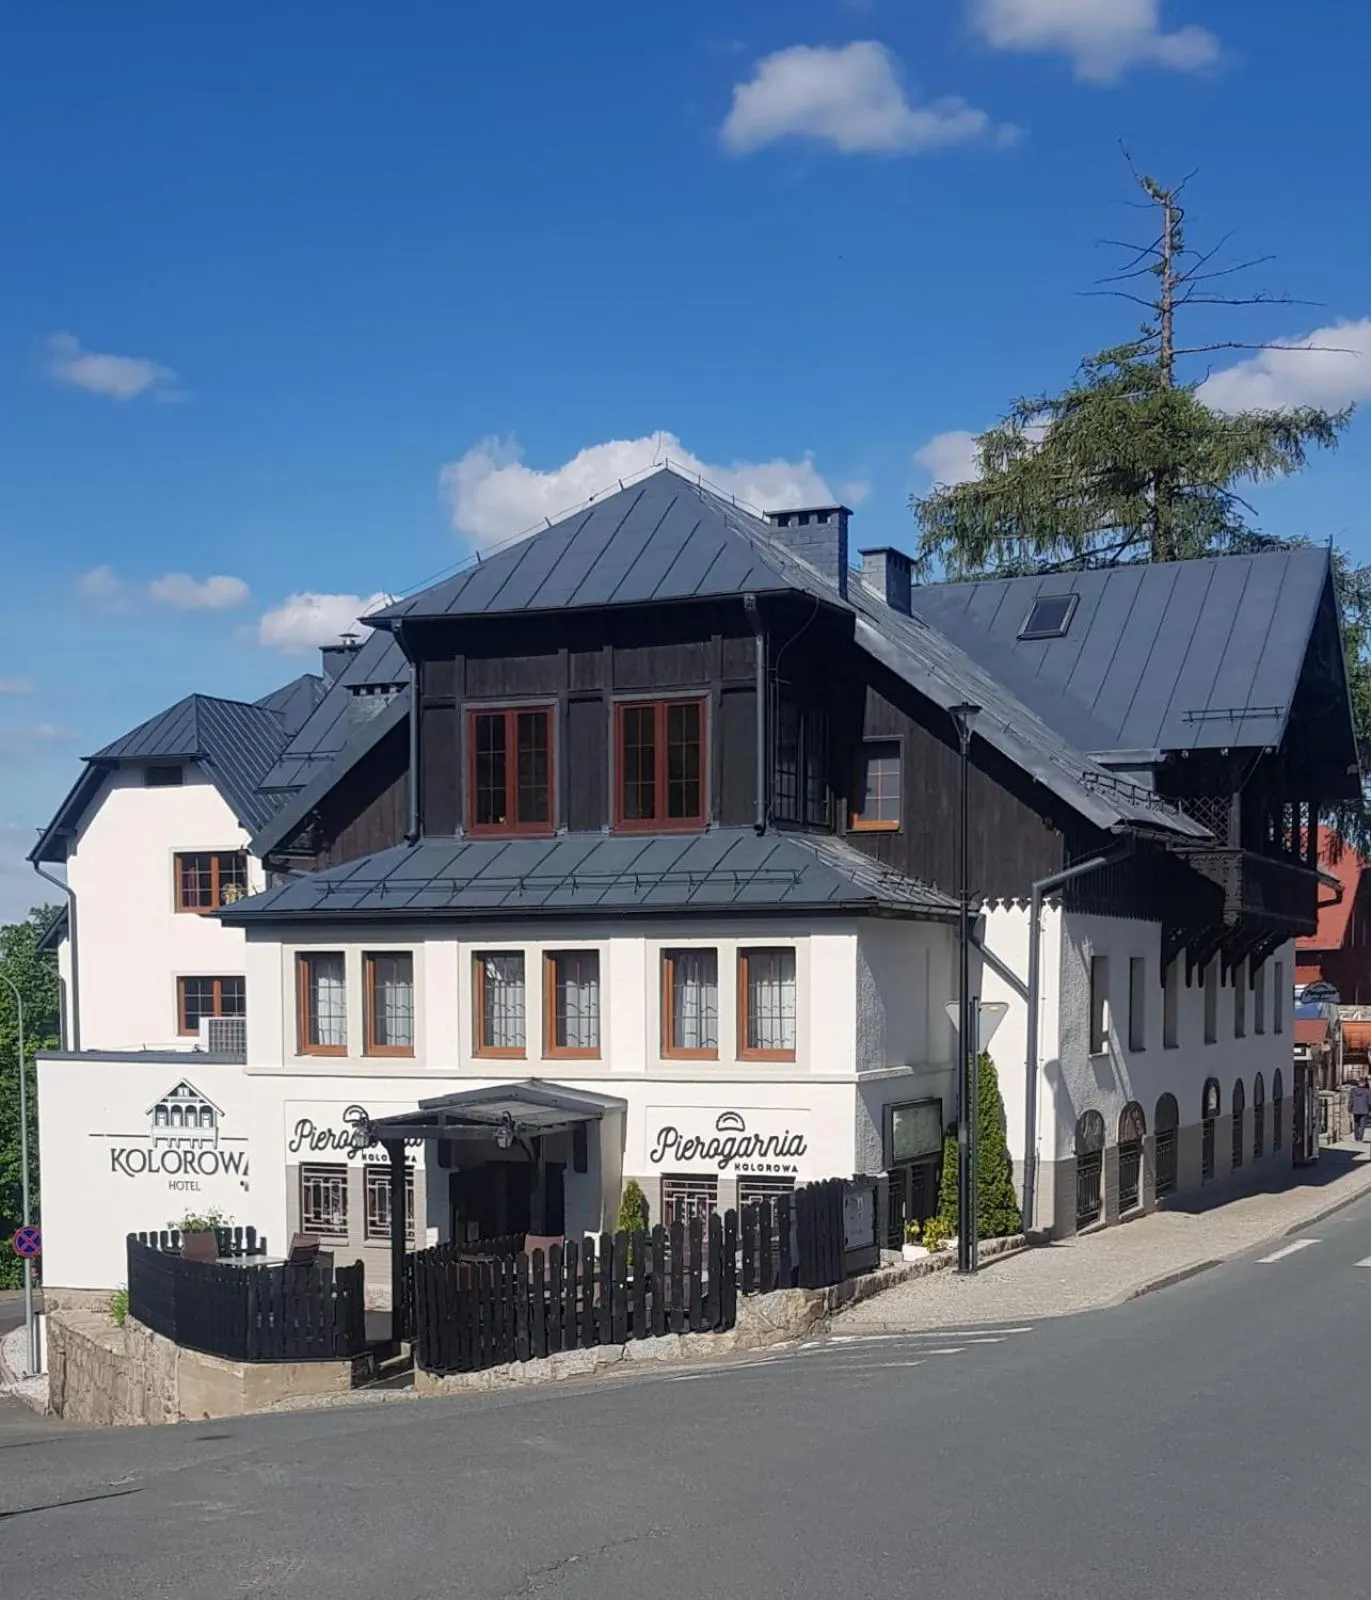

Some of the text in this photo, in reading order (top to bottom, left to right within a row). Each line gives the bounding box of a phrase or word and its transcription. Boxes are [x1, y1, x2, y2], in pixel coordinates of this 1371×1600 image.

[650, 1126, 808, 1170] Pierogarnia
[734, 1163, 799, 1173] KOLOROWA
[168, 1180, 202, 1192] HOTEL
